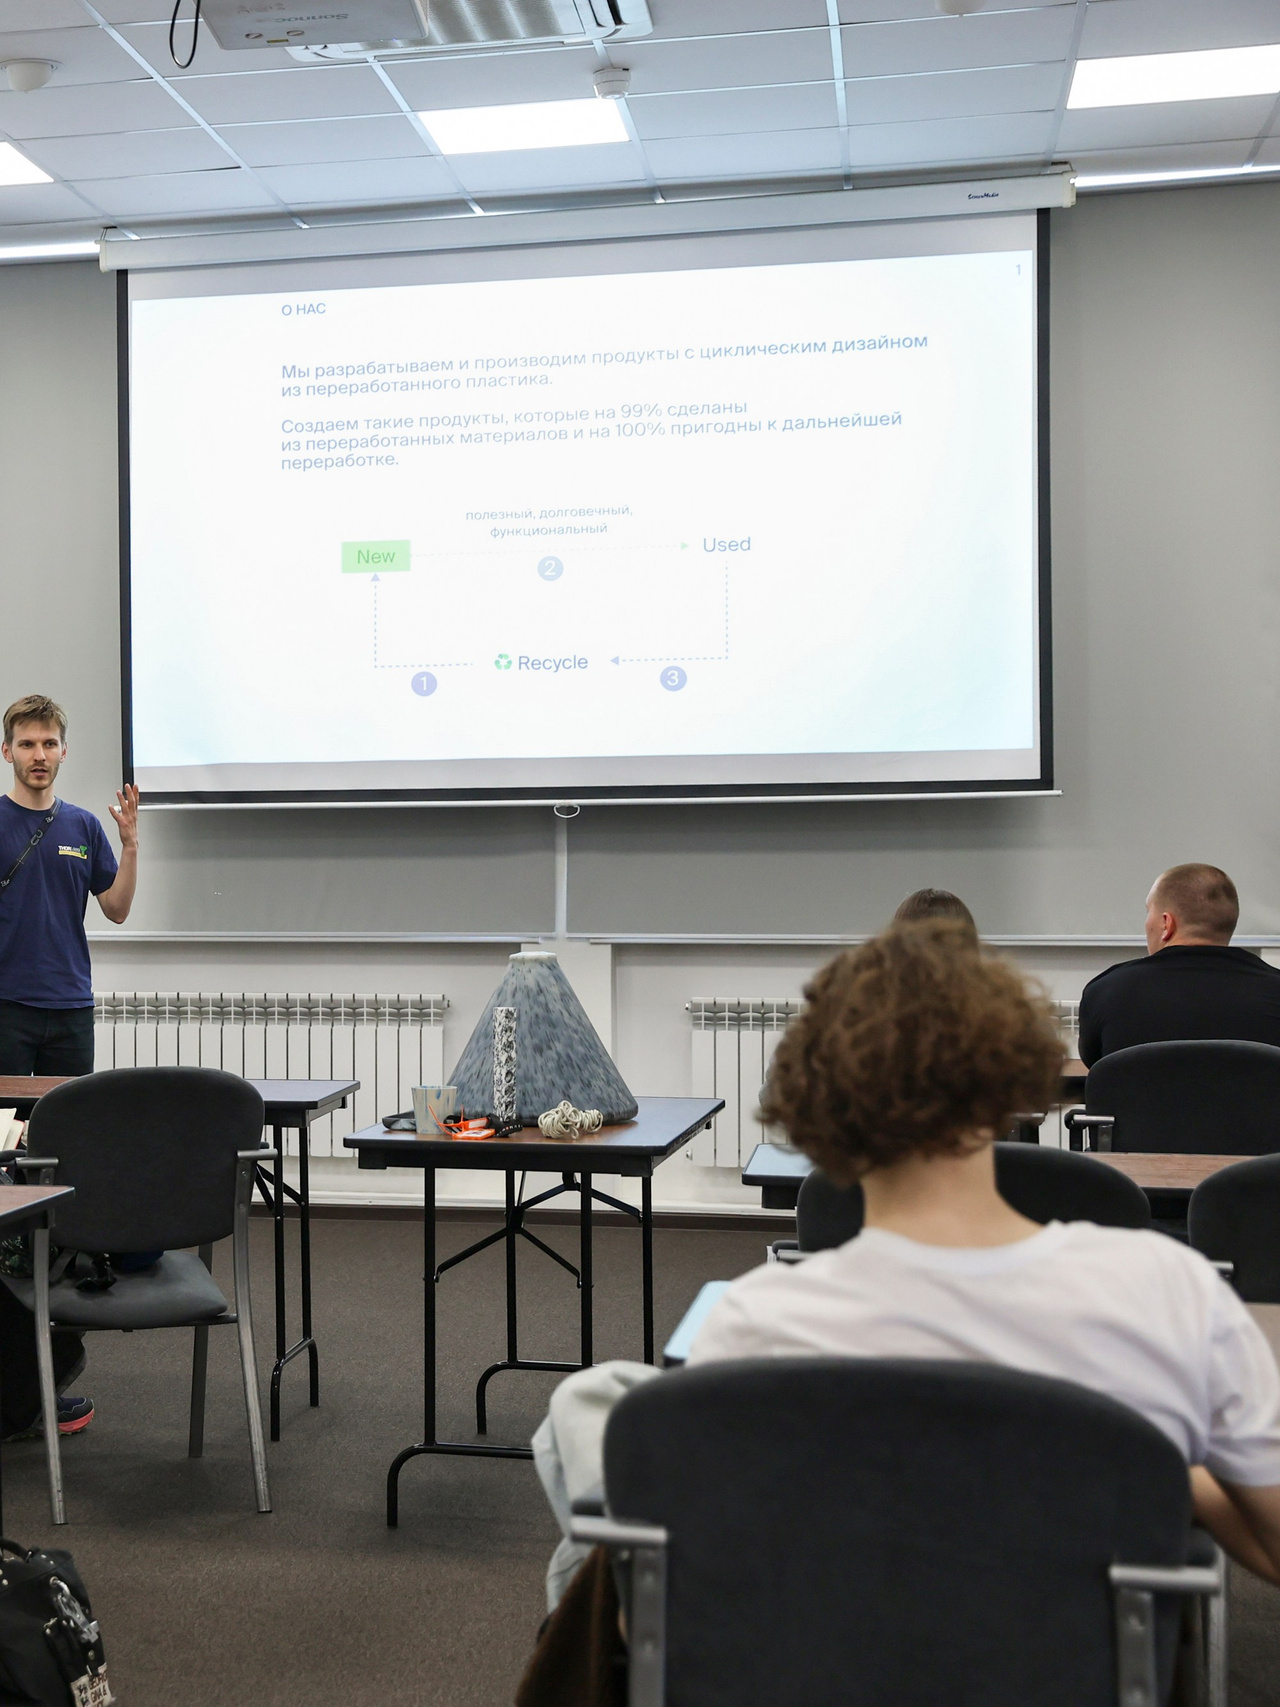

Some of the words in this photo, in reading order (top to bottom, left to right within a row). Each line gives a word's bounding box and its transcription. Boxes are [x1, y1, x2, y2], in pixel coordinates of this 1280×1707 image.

[1015, 263, 1021, 276] 1
[281, 304, 292, 316] О
[296, 302, 326, 315] НАС
[281, 364, 310, 379] Мы
[314, 360, 453, 380] разрабатываем
[459, 359, 469, 370] и
[474, 354, 586, 370] производим
[592, 349, 679, 366] продукты
[684, 348, 694, 359] с
[700, 341, 827, 360] циклическим
[831, 334, 928, 354] дизайном
[281, 385, 301, 397] из
[305, 381, 461, 398] переработанного
[466, 374, 553, 388] пластика.
[281, 417, 359, 434] Создаем
[363, 417, 415, 430] такие
[418, 413, 509, 430] продукты,
[513, 409, 589, 425] которые
[594, 408, 616, 420] на
[620, 402, 663, 419] 99%
[667, 402, 747, 418] сделаны
[281, 440, 301, 452] из
[306, 434, 455, 453] переработанных
[459, 429, 568, 445] материалов
[573, 428, 584, 439] и
[589, 426, 610, 439] на
[615, 421, 665, 437] 100%
[670, 420, 761, 438] пригодны
[767, 419, 777, 431] к
[781, 410, 902, 432] дальнейшей
[281, 453, 399, 472] переработке.
[465, 507, 536, 521] полезный,
[537, 503, 633, 520] долговечный,
[489, 521, 608, 539] функциональный
[703, 535, 751, 553] Used
[357, 548, 396, 564] New
[544, 559, 556, 576] 2
[518, 653, 589, 673] Recycle
[666, 669, 681, 686] 3
